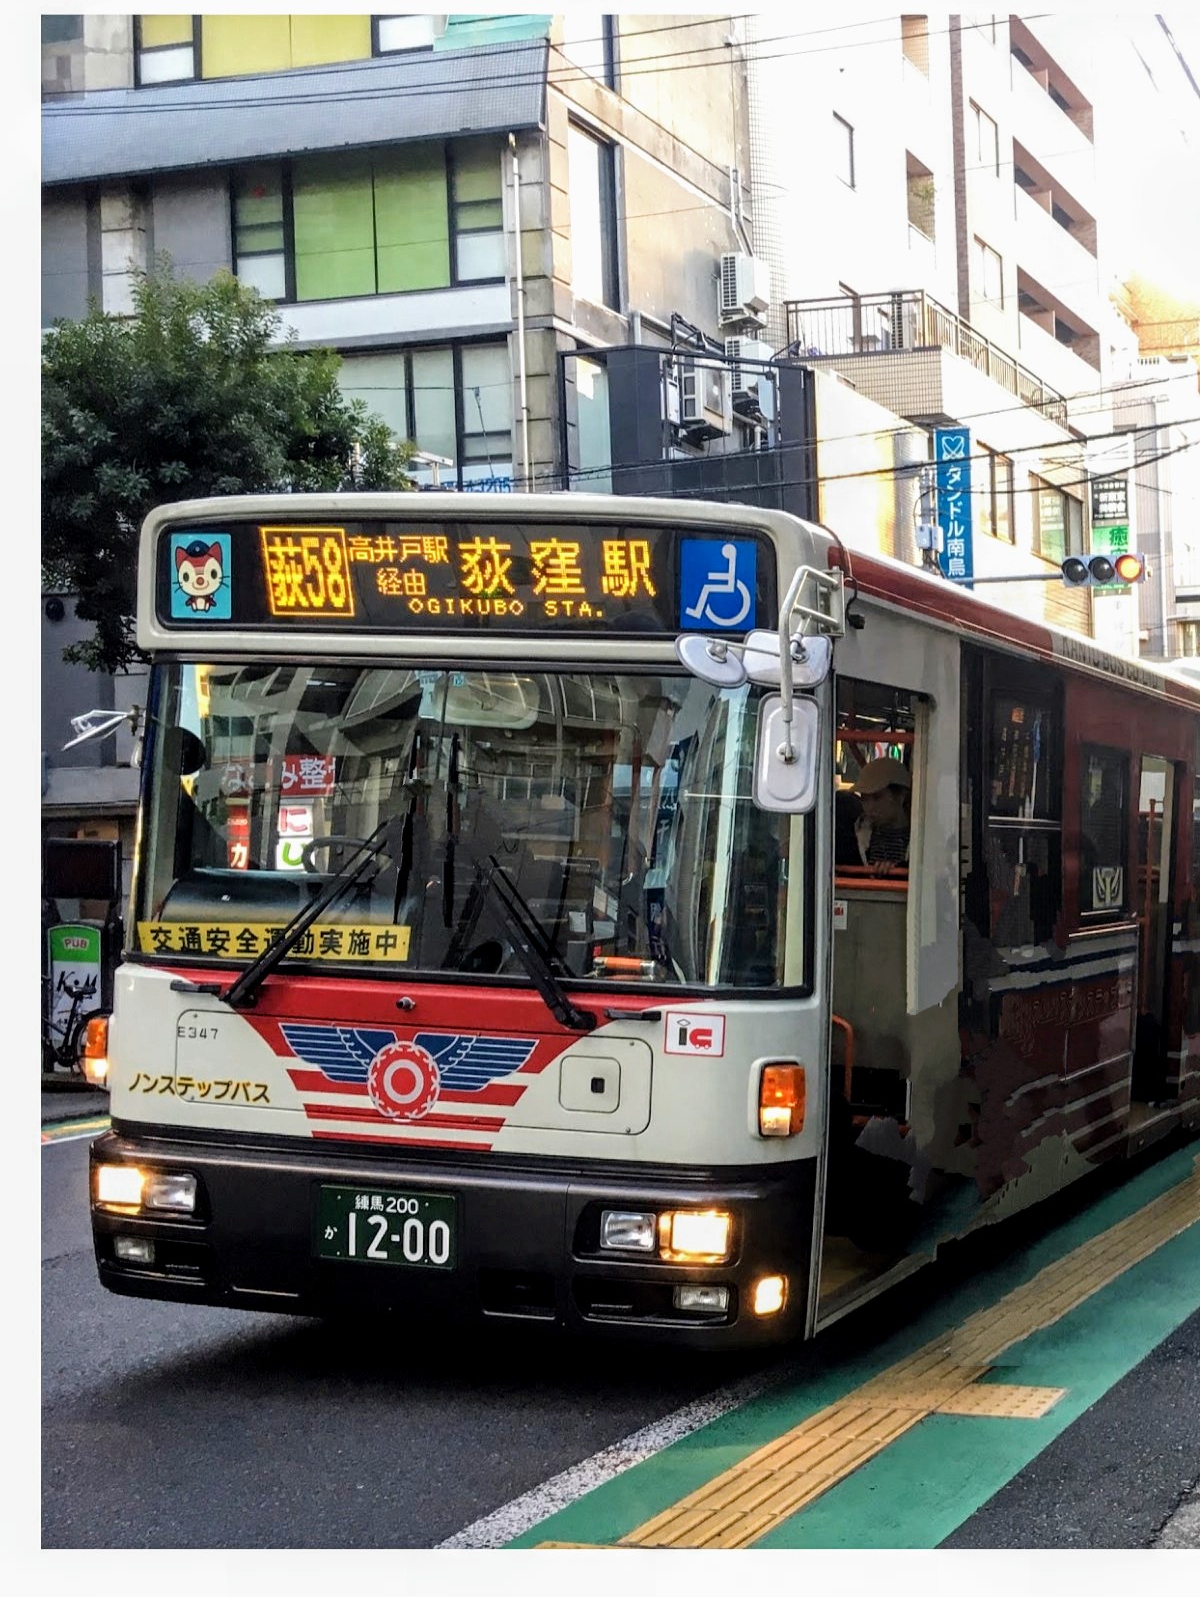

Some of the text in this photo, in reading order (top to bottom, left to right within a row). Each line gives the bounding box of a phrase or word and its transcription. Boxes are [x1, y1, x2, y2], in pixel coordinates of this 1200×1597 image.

[349, 536, 658, 598] 高井戸駅 荻窪駅
[376, 568, 426, 596] 経由
[409, 598, 604, 618] OGIKUBO STA.
[64, 938, 88, 950] PUB
[150, 926, 398, 957] 交通安全運動実施中
[178, 1026, 219, 1040] E347
[128, 1073, 271, 1104] ノンステップバス
[354, 1194, 420, 1215] 練馬200
[324, 1213, 451, 1264] か 12-00
